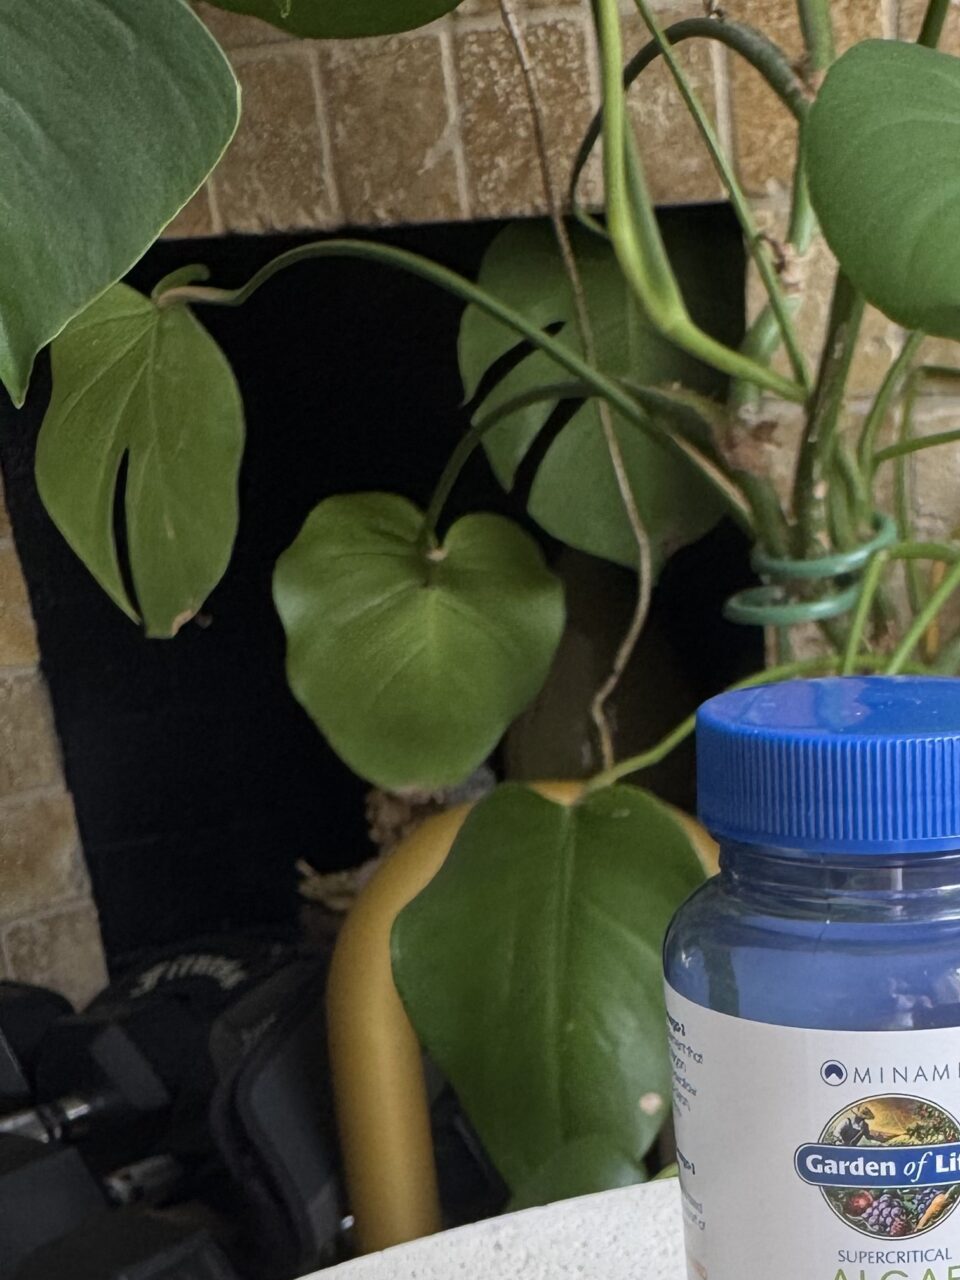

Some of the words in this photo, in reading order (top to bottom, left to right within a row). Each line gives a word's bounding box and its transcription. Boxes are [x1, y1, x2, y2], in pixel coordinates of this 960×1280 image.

[805, 1154, 896, 1177] Garden
[902, 1150, 932, 1181] of
[838, 1247, 952, 1264] SUPERCRITICAL
